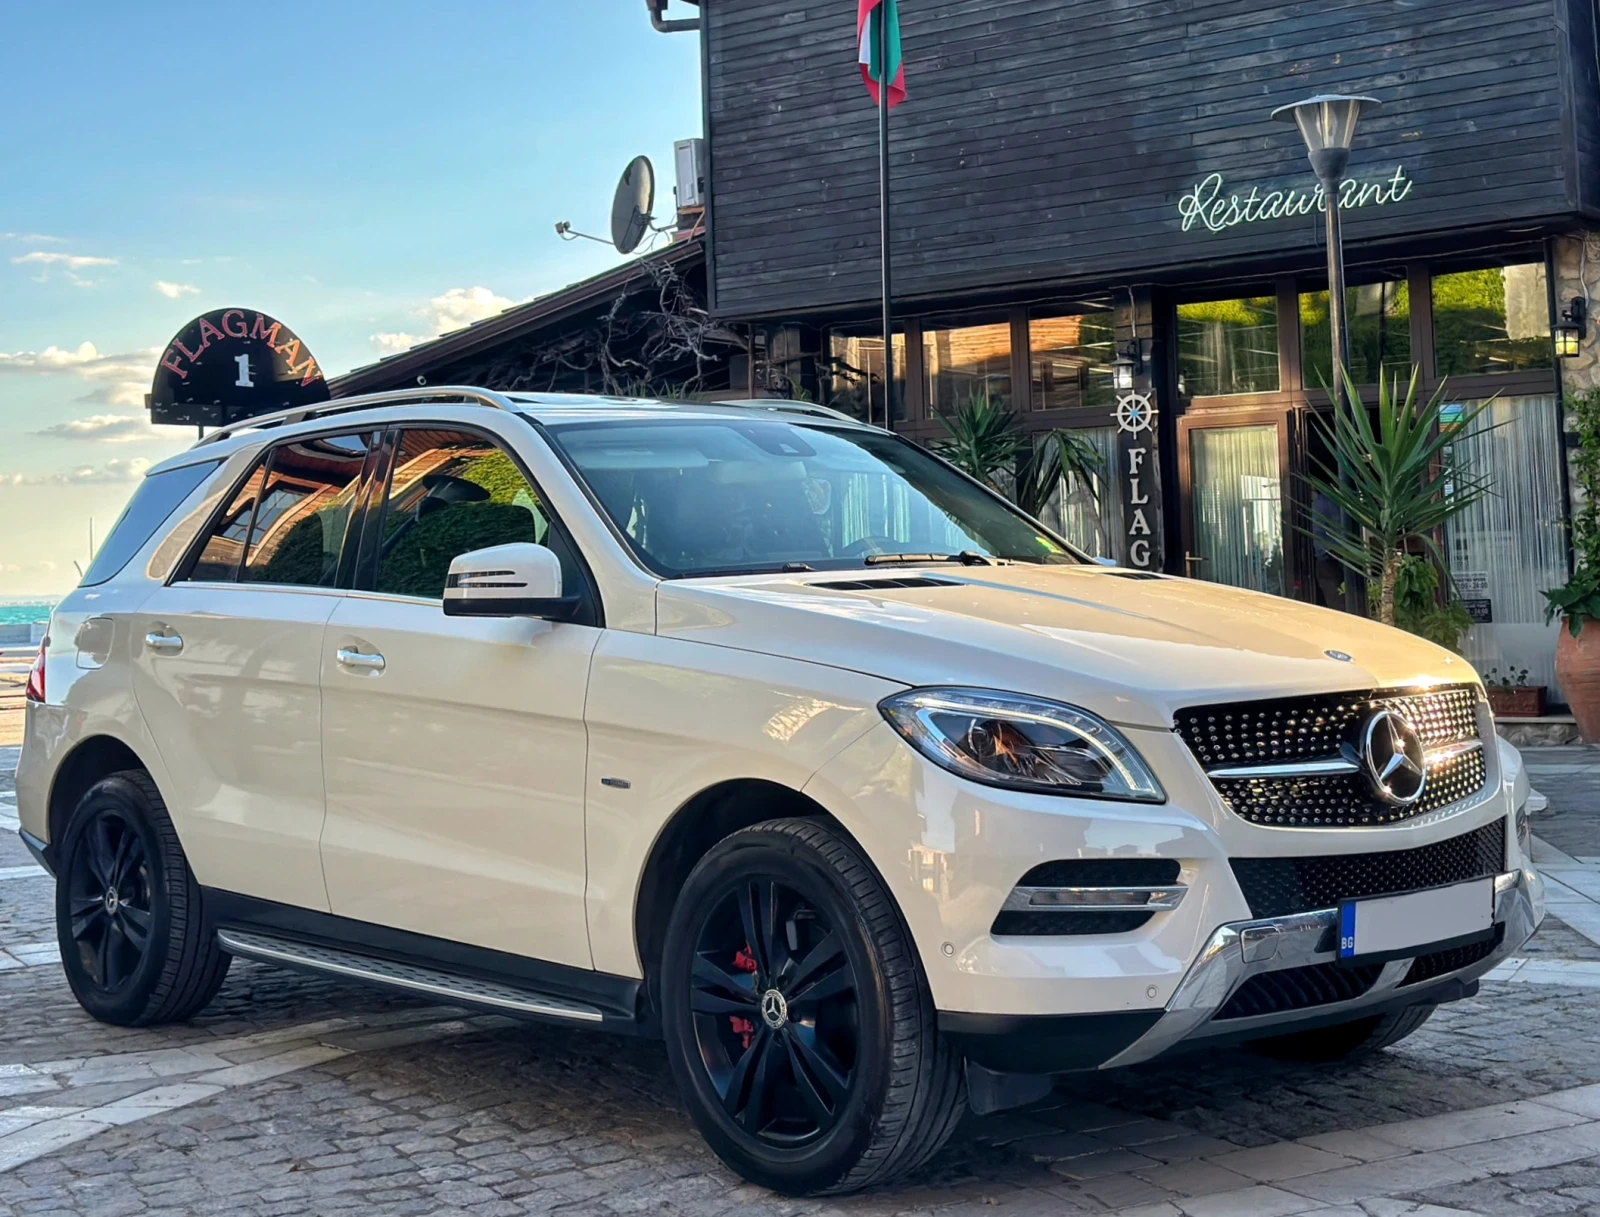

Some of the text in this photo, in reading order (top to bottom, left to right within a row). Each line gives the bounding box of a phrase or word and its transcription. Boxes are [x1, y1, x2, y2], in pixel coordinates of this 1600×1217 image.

[1178, 165, 1412, 231] Restaurant
[161, 309, 322, 387] FLAGMAN
[234, 353, 254, 387] 1
[1128, 447, 1151, 567] FLAG
[1341, 936, 1354, 949] BG
